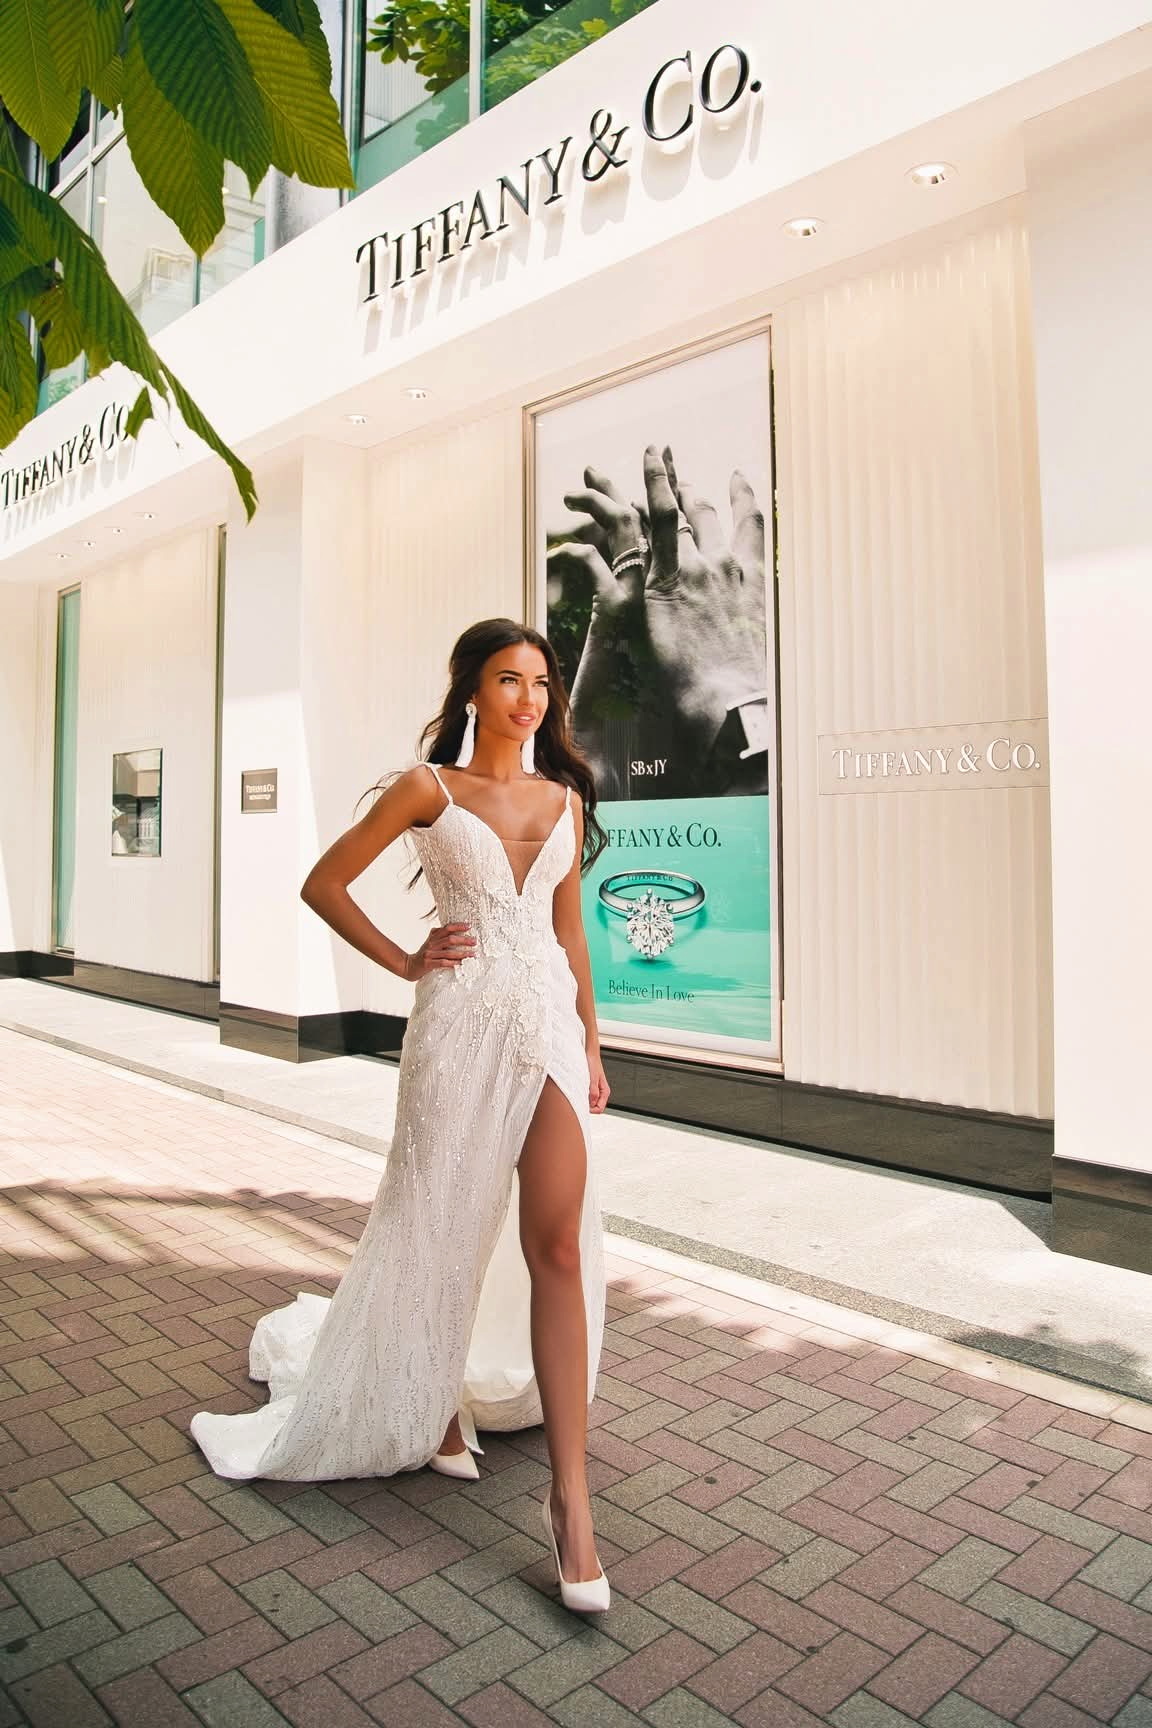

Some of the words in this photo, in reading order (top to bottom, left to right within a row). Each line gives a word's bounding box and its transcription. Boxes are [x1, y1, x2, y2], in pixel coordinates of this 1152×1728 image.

[356, 136, 573, 303] TIFFANY
[582, 109, 630, 182] &
[642, 44, 762, 141] CO.
[1, 435, 77, 510] TIFFANY
[79, 424, 95, 465] &
[100, 402, 130, 451] CO
[832, 748, 952, 779] TIFFANY
[957, 743, 982, 773] &
[986, 737, 1041, 772] CO.
[607, 828, 664, 847] FFANY
[667, 825, 683, 847] &
[686, 822, 722, 848] CO.
[608, 979, 648, 998] Believe
[651, 983, 663, 1000] In
[665, 985, 695, 1003] Love
